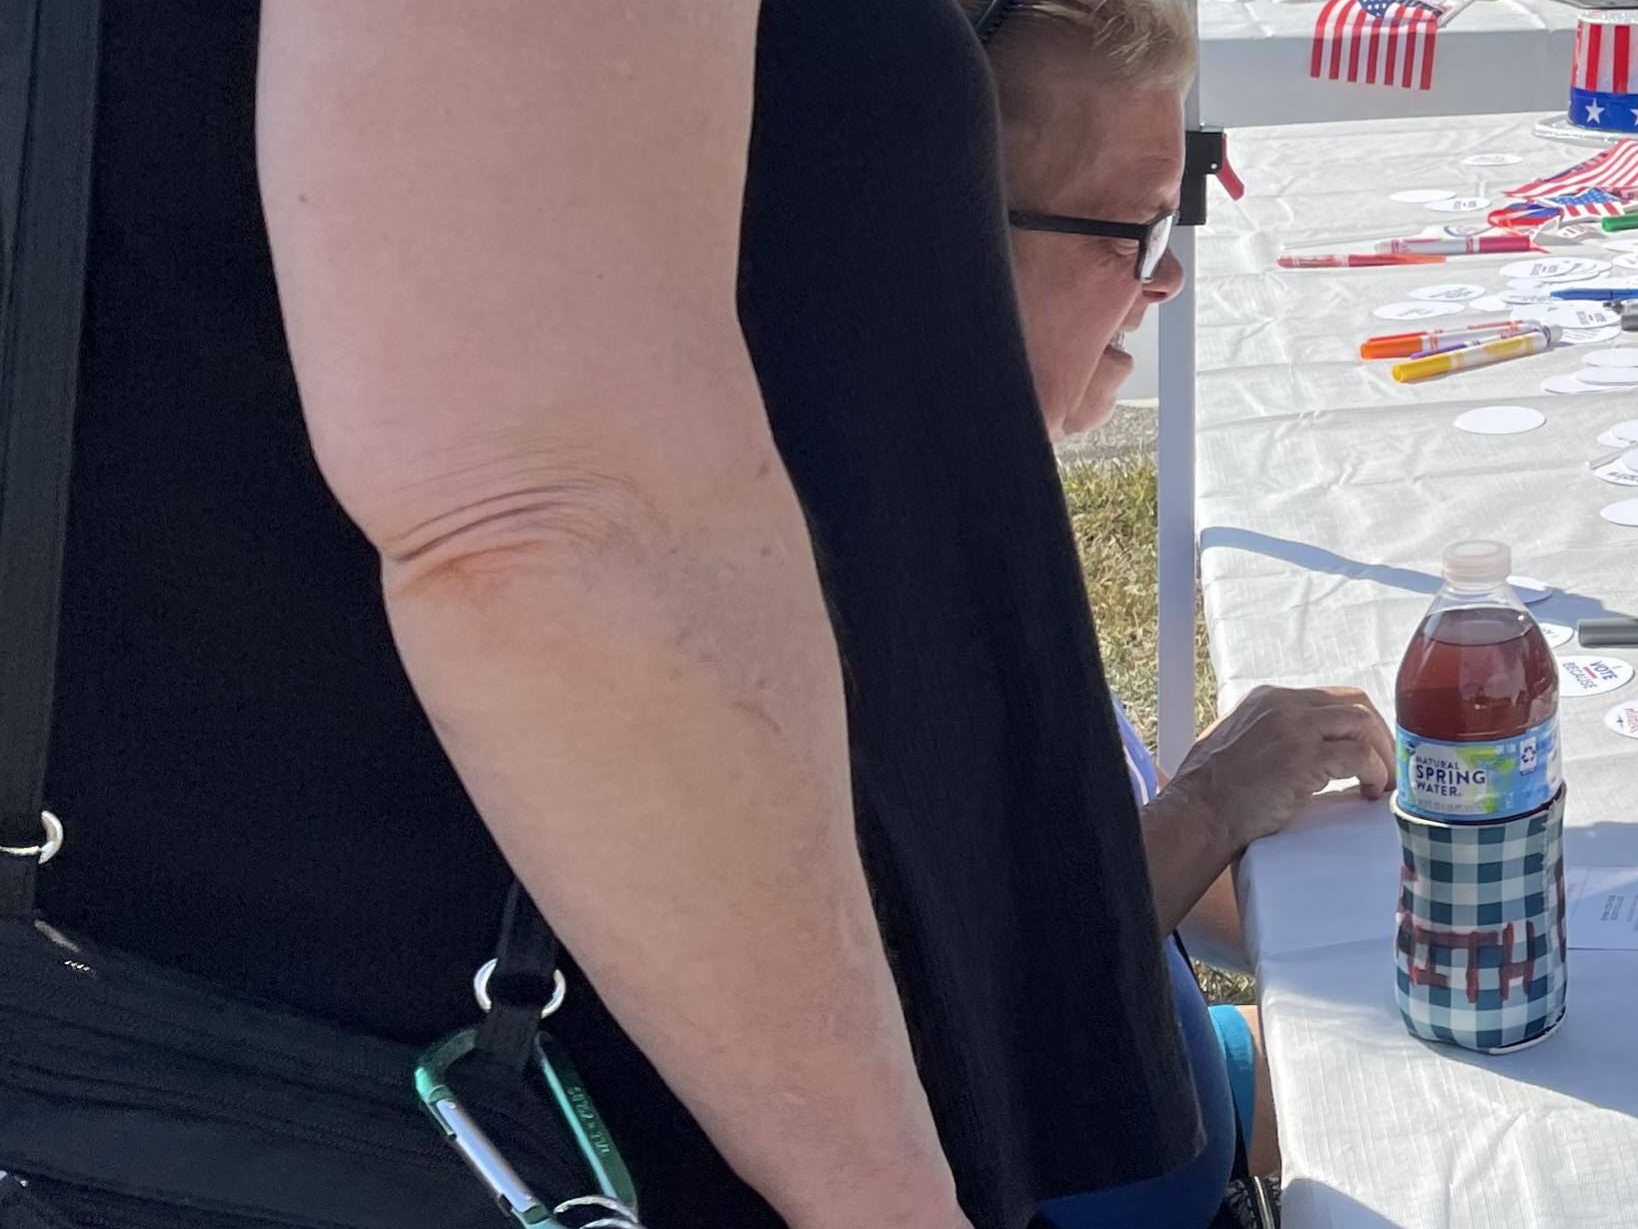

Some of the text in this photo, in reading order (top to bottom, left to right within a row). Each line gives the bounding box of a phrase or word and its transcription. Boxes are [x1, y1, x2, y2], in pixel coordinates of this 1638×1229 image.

[1591, 661, 1619, 681] VOTE
[1416, 755, 1460, 770] NATURAL
[1416, 764, 1486, 785] SPRING
[1416, 781, 1458, 797] WATER
